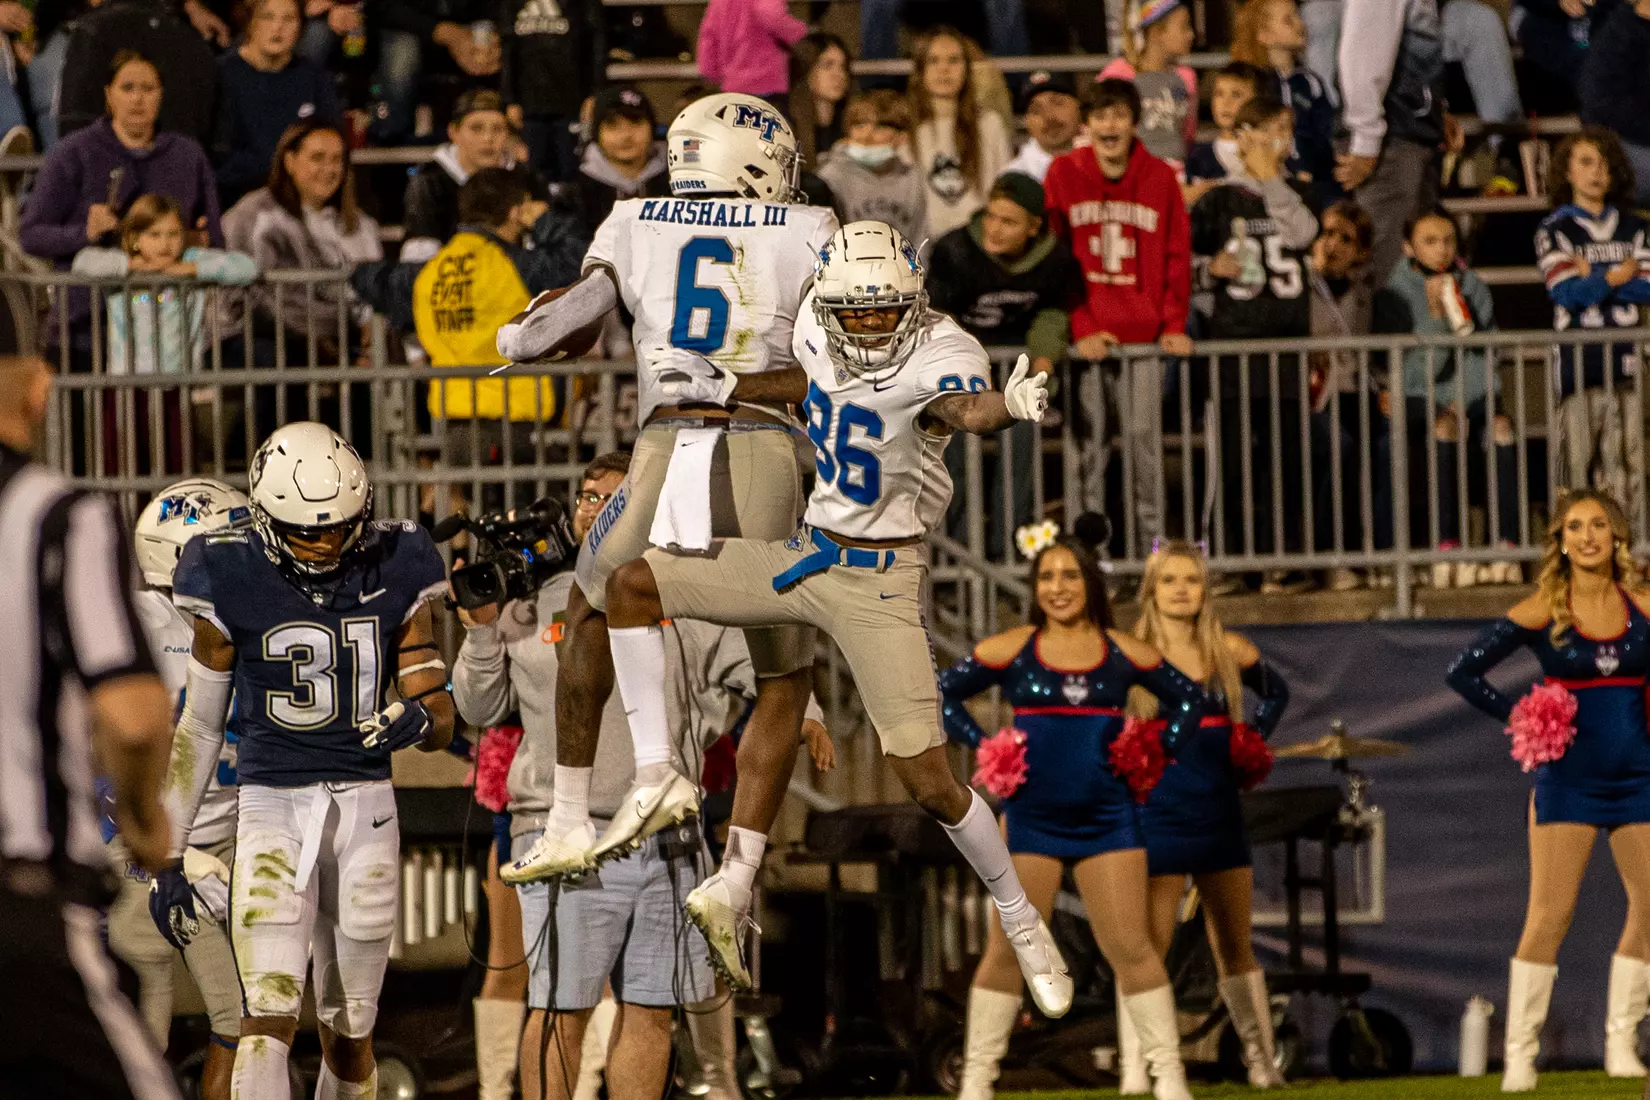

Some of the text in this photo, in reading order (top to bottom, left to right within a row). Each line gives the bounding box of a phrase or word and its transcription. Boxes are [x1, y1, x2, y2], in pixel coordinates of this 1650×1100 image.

[733, 104, 783, 143] MT
[638, 200, 788, 227] MARSHALL III
[667, 234, 737, 356] 6
[803, 377, 886, 507] 86
[588, 487, 626, 556] RAIDERS
[262, 616, 382, 731] 31
